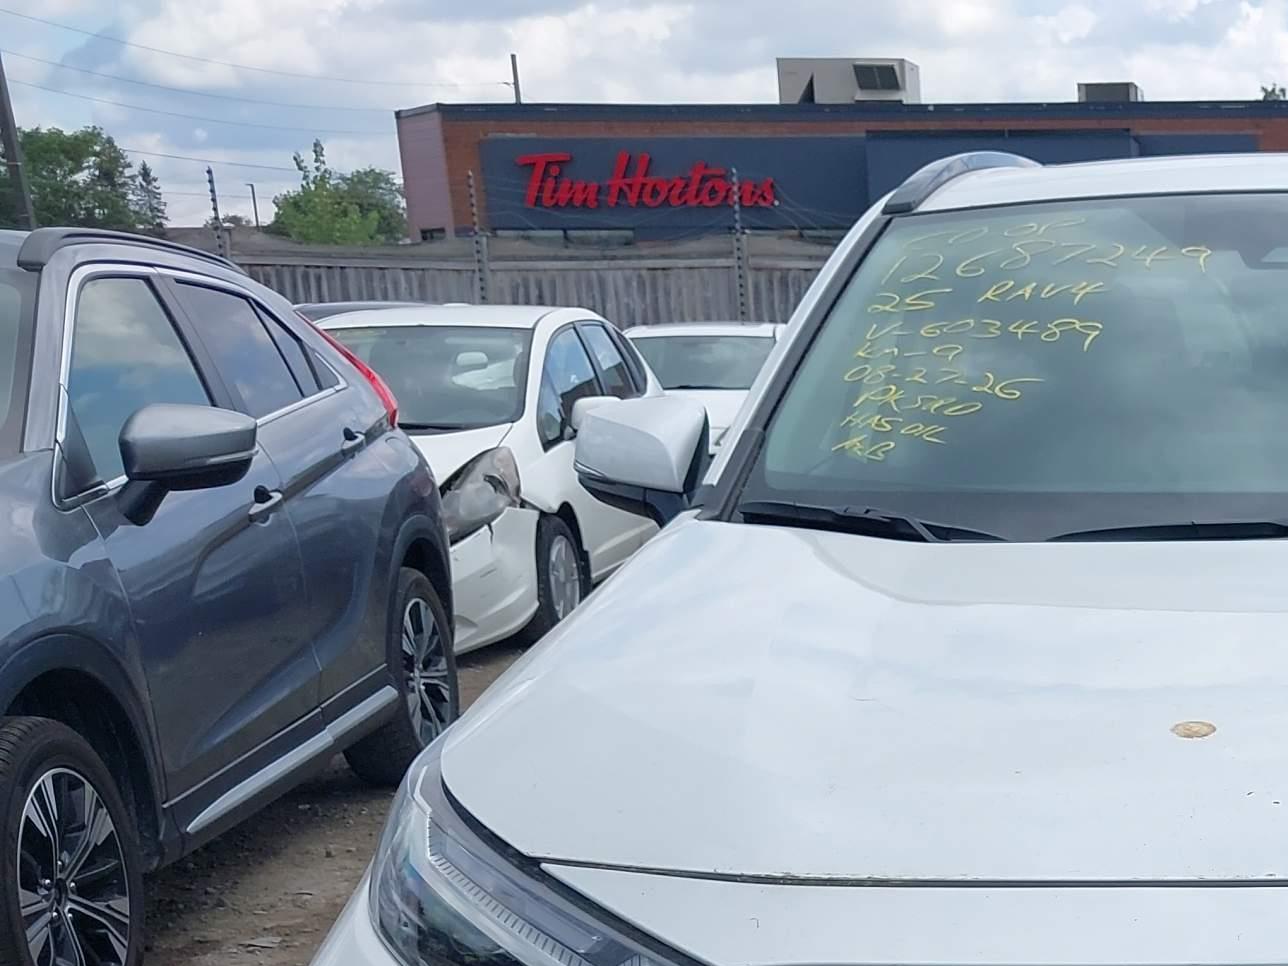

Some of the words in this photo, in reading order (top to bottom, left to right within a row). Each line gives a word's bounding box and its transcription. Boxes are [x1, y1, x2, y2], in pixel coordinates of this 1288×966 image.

[515, 152, 599, 208] Tim
[607, 150, 776, 208] Hortons
[881, 239, 1212, 286] 12687249
[976, 279, 1110, 306] RAV4
